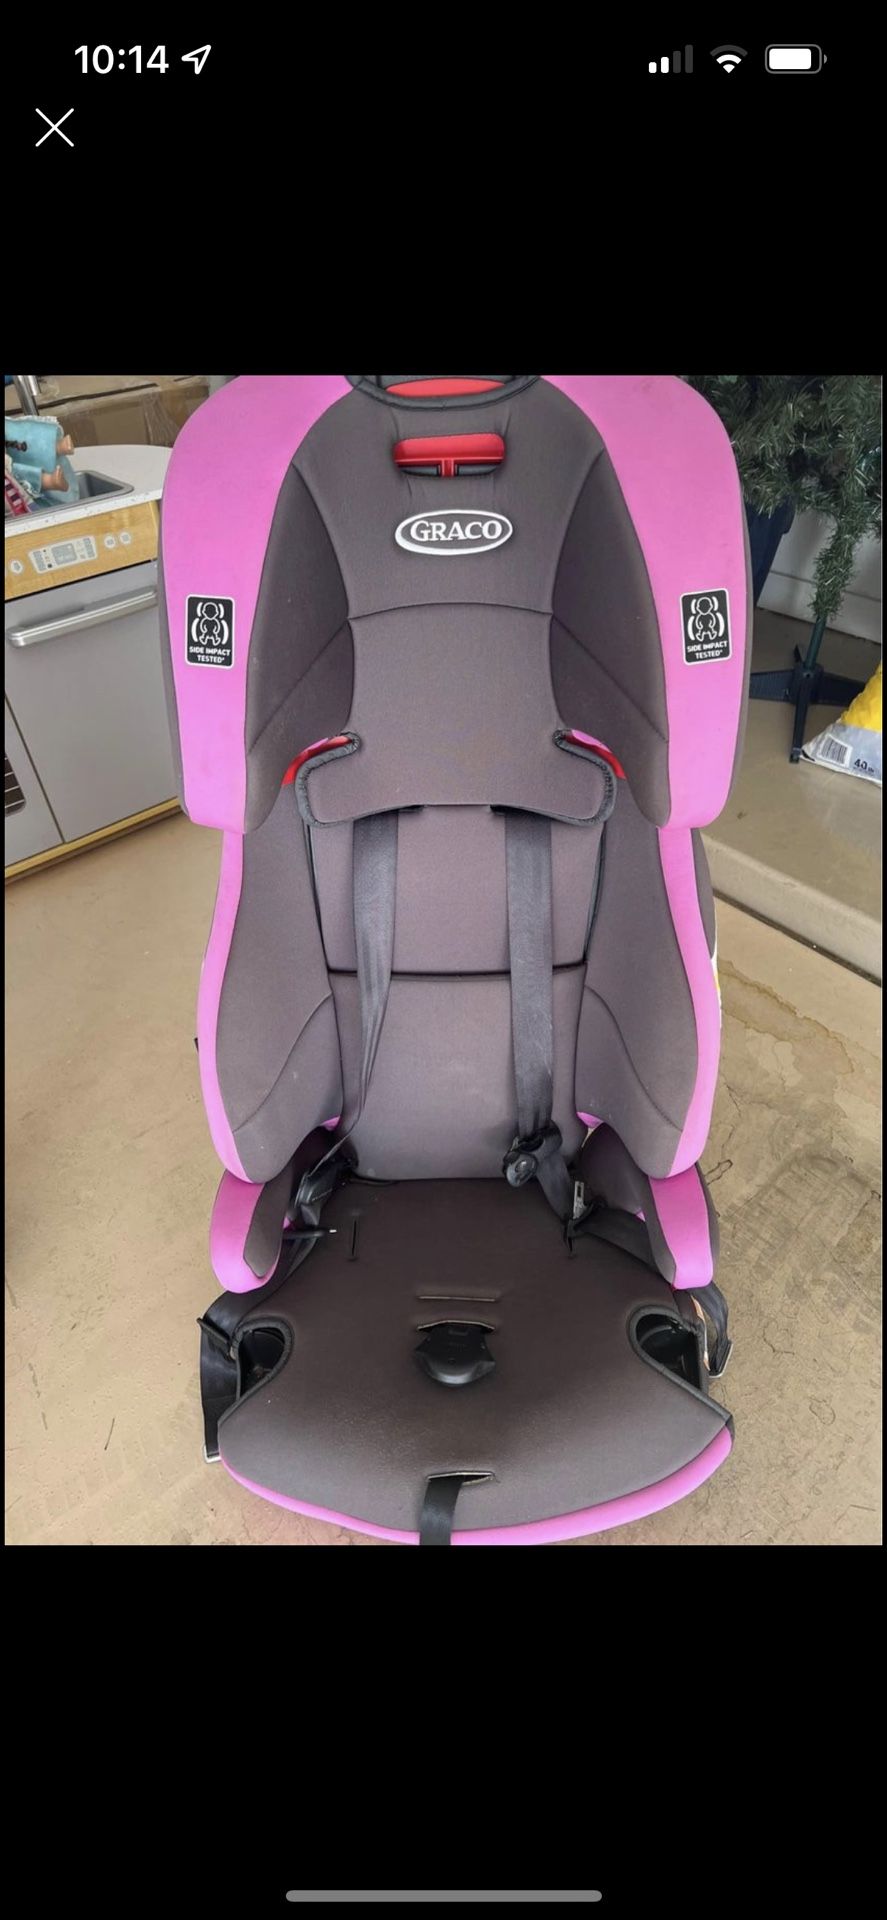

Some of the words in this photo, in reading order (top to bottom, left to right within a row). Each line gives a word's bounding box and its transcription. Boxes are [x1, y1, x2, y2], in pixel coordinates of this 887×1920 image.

[410, 520, 502, 541] GRACO
[205, 648, 231, 656] IMPACT
[687, 644, 702, 652] SIDE
[703, 641, 728, 650] IMPACT
